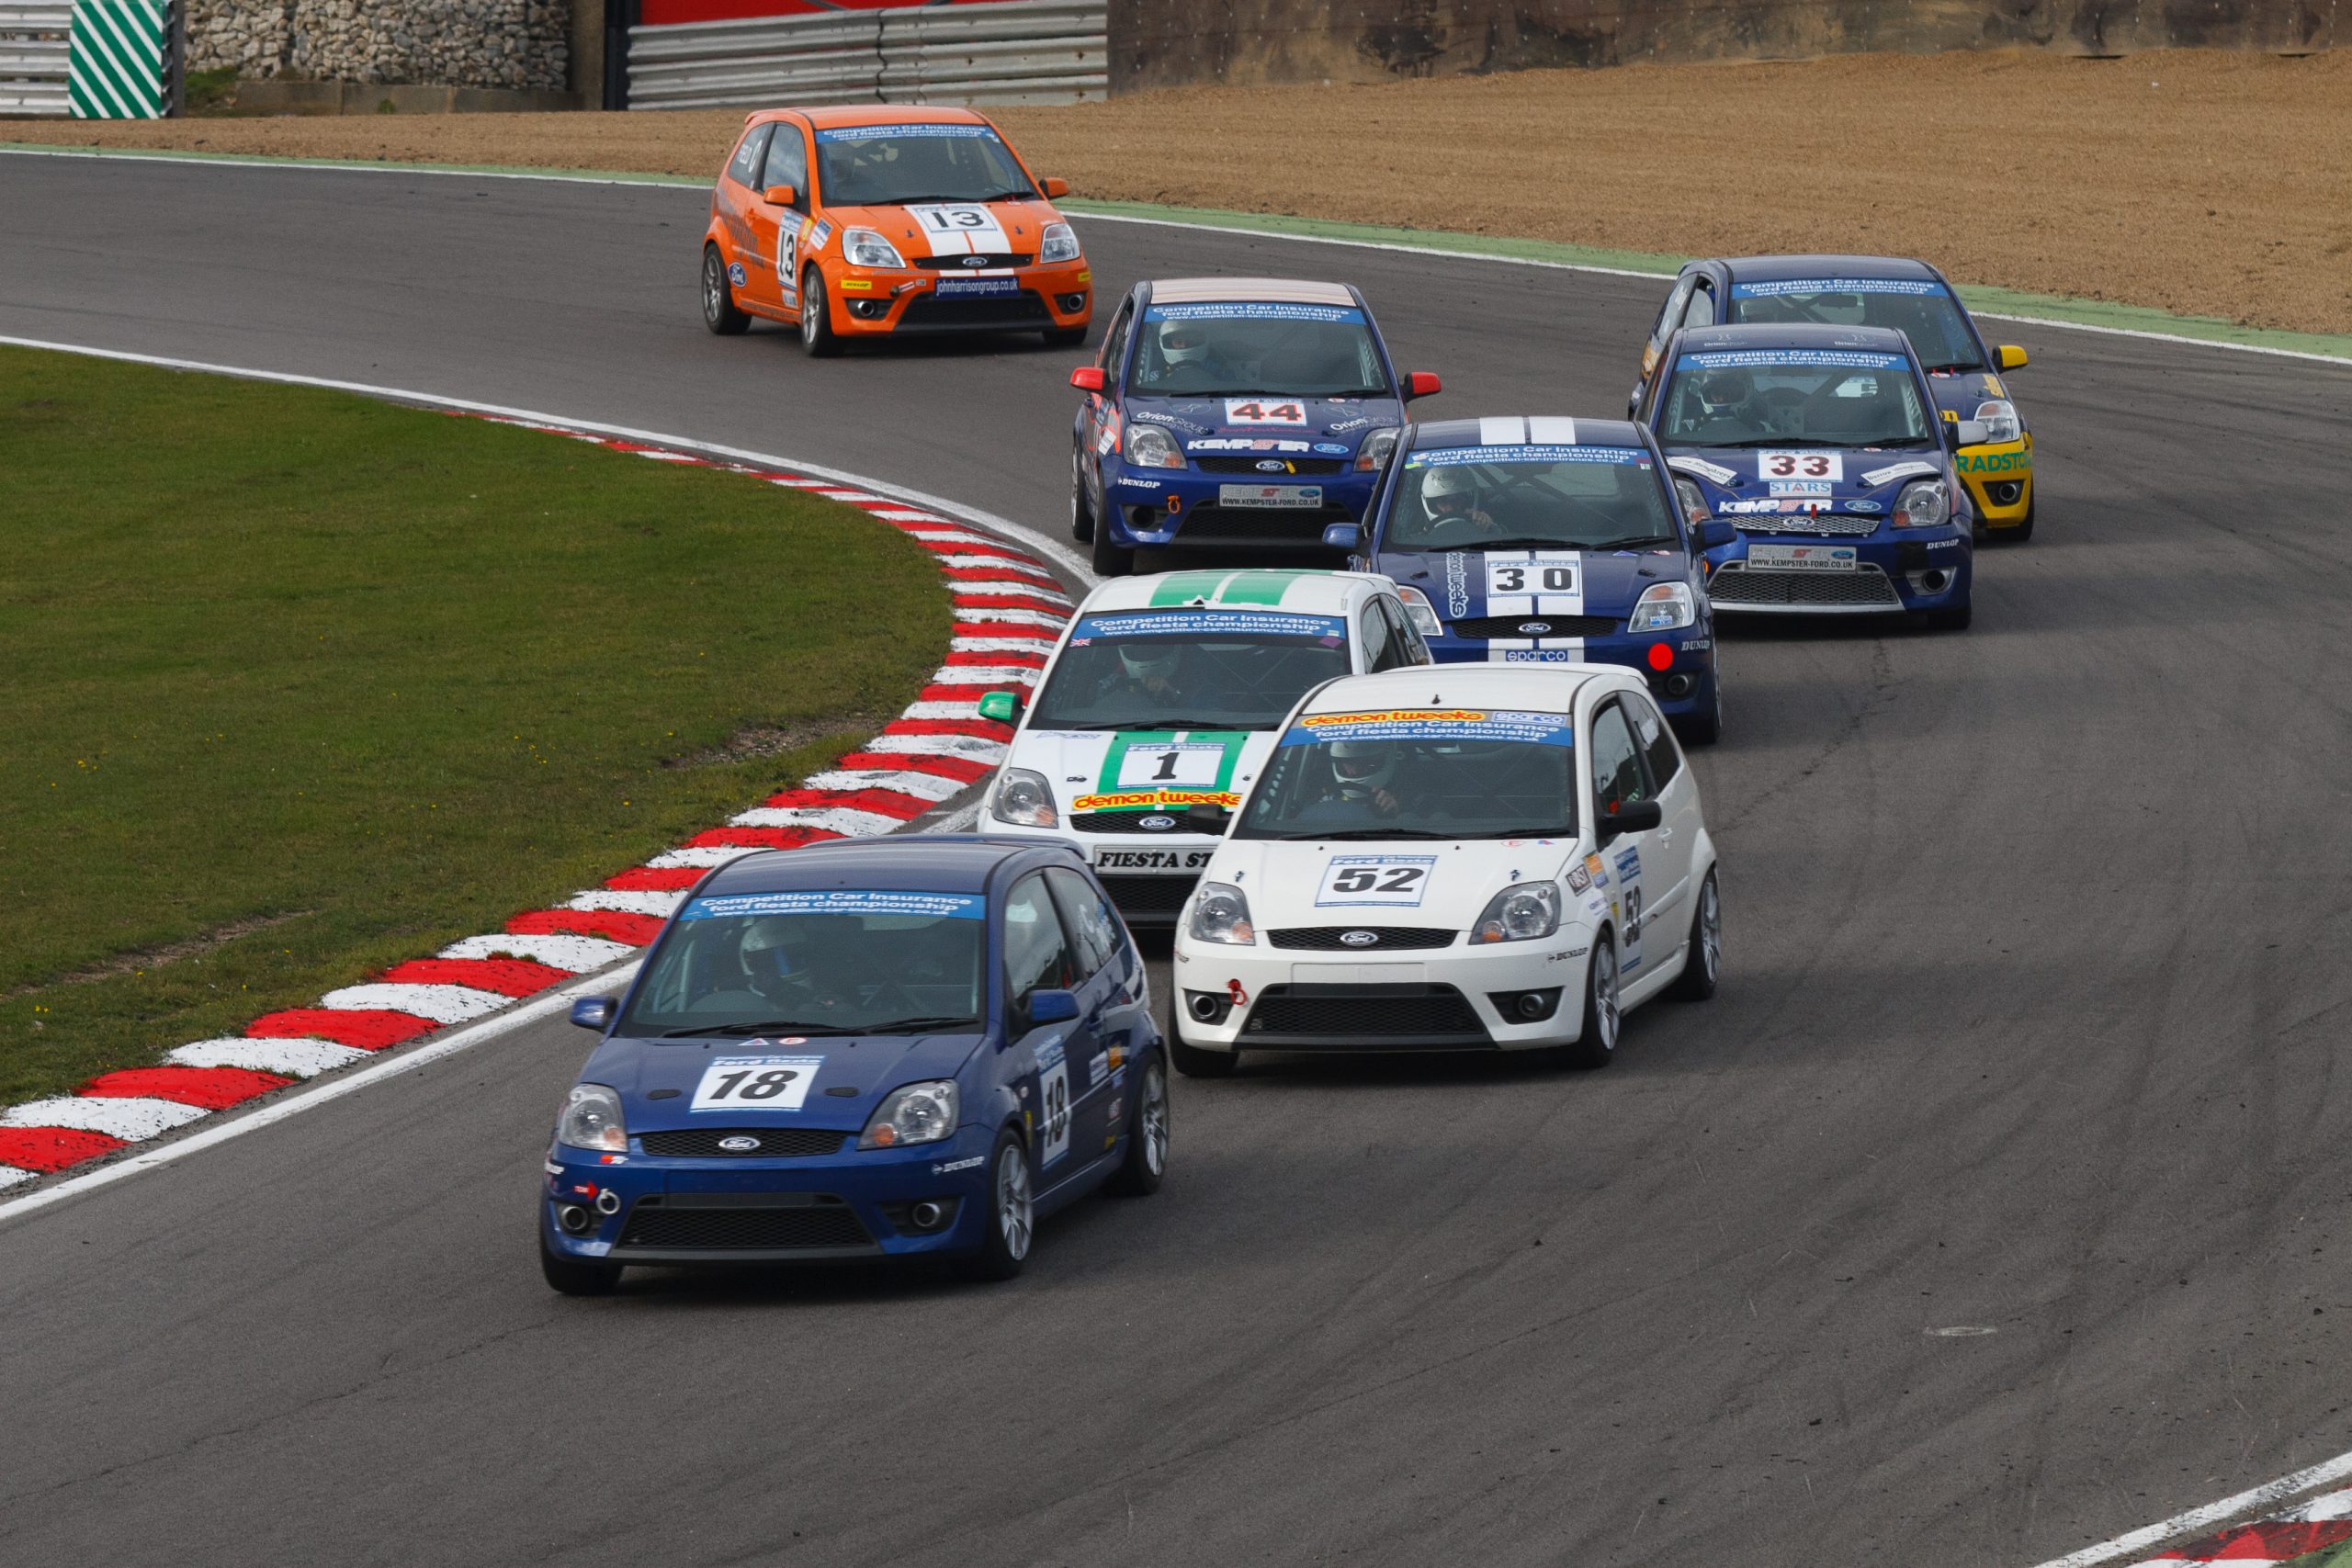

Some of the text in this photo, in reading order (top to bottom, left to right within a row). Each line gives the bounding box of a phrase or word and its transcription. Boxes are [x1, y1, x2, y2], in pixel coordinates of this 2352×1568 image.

[931, 211, 985, 228] 13
[780, 231, 795, 279] 13
[936, 278, 1018, 296] johnharrisongroup.co.uk
[1741, 279, 1829, 289] Competition
[1862, 279, 1935, 288] Insurance
[1153, 304, 1241, 313] Competition
[1275, 304, 1350, 315] Insurance
[1690, 351, 1786, 361] Competition
[1820, 351, 1897, 361] Insurance
[1780, 355, 1890, 366] championship
[1232, 403, 1303, 421] 44
[1187, 438, 1310, 452] KEMPSTER
[1423, 446, 1520, 457] Competition
[1555, 446, 1638, 457] Insurance
[1260, 462, 1282, 470] Ford
[1770, 455, 1830, 476] 33
[1121, 478, 1160, 488] DUNLOP
[1770, 483, 1830, 492] STARS
[1222, 497, 1319, 506] WWW.KEMPSTER-FORD.CO.UK
[1788, 518, 1811, 527] Ford
[1927, 538, 1960, 549] DUNLOP
[1751, 558, 1853, 570] WWW.KEMPSTER-FORD.CO.UK
[1496, 568, 1572, 592] 30
[1091, 615, 1201, 626] Competition
[1241, 615, 1331, 626] Insurance
[1100, 621, 1320, 632] ford fiesta championship
[1522, 624, 1547, 632] Ford
[1507, 650, 1566, 662] sparco
[1303, 711, 1484, 727] demon tweeks
[1496, 712, 1564, 723] sparco
[1306, 721, 1422, 732] Competition
[1463, 720, 1559, 732] Insurance
[1315, 727, 1548, 738] ford fiesta championship
[1151, 752, 1181, 780] 1
[1074, 794, 1153, 808] demon
[1143, 818, 1171, 829] Ford
[1097, 852, 1214, 867] FIESTA ST
[1332, 868, 1425, 893] 52
[701, 893, 825, 907] Competition
[868, 893, 972, 905] Insurance
[708, 900, 958, 912] ford fiesta championship
[1345, 932, 1374, 944] Ford
[708, 1070, 798, 1100] 18
[723, 1137, 756, 1149] Ford
